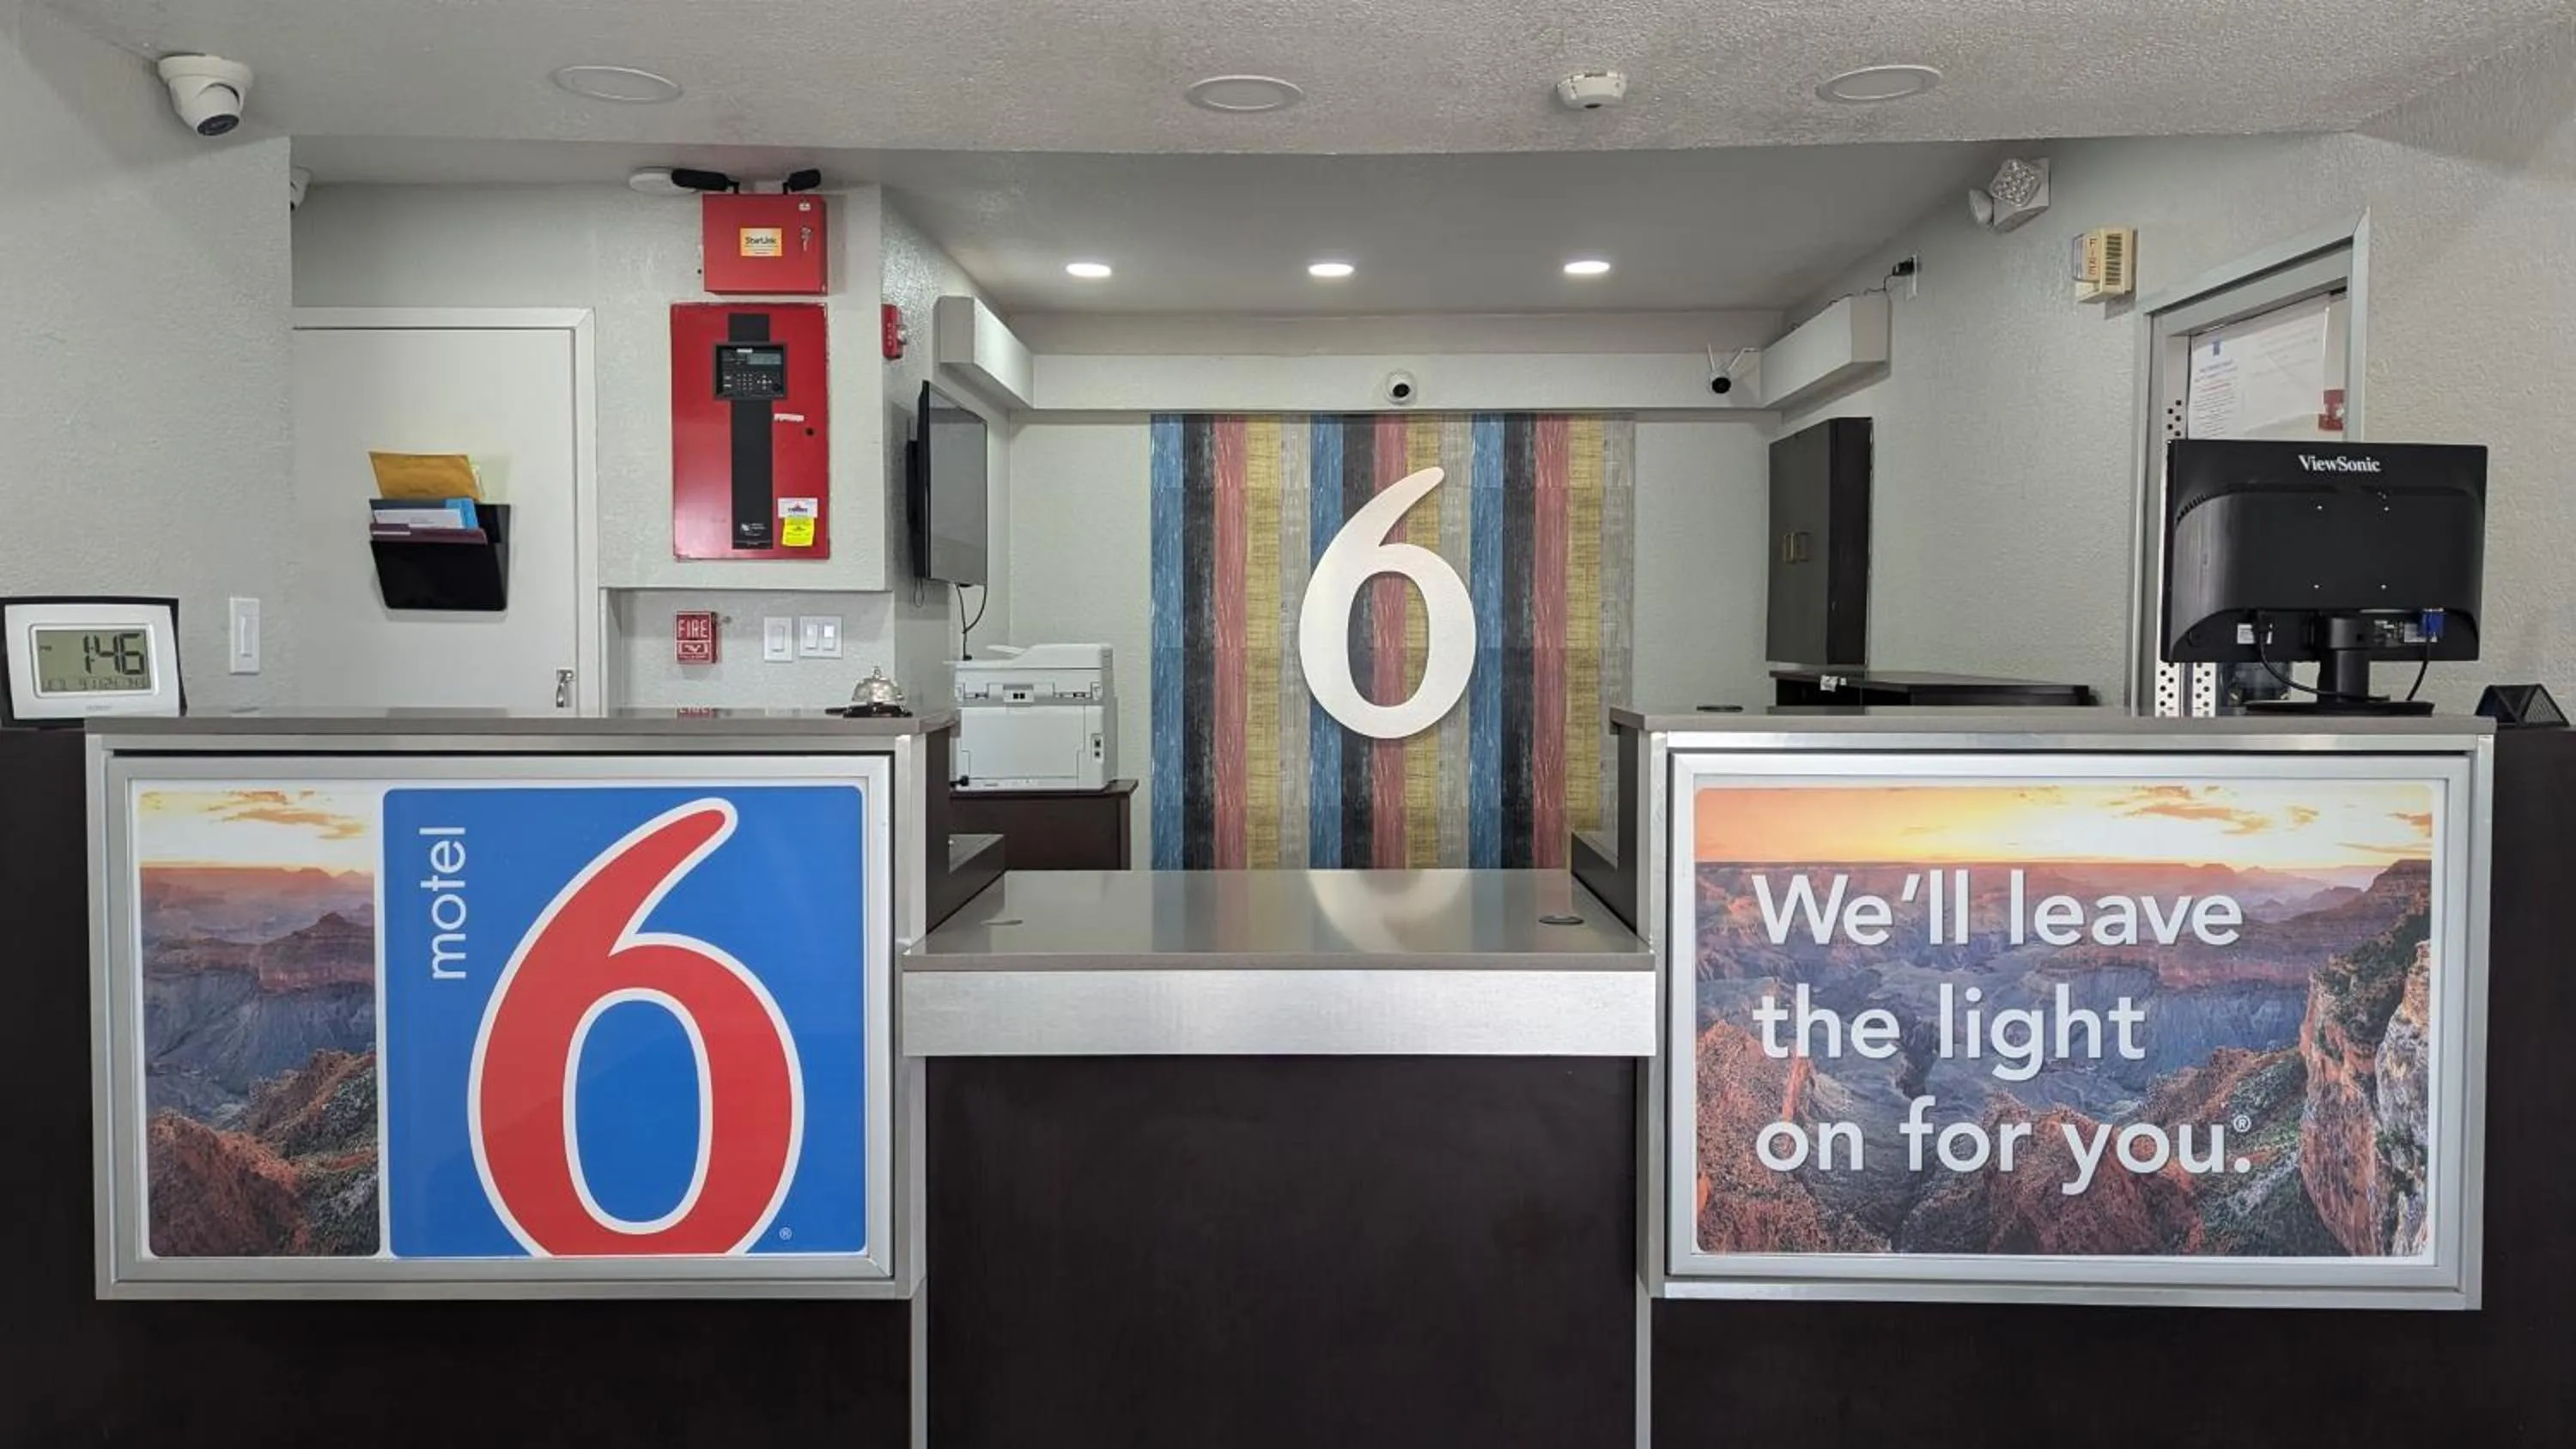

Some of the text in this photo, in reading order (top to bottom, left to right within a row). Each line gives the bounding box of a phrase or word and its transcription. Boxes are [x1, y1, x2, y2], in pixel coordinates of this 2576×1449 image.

[2298, 454, 2381, 472] ViewSonic
[678, 619, 708, 639] FIRE
[1299, 466, 1476, 739] 6
[419, 827, 466, 979] motel
[1753, 869, 2244, 945] We’ll leave
[467, 797, 805, 1257] 6
[1753, 983, 2146, 1081] the light
[1755, 1120, 1864, 1172] on
[1899, 1095, 2032, 1172] for
